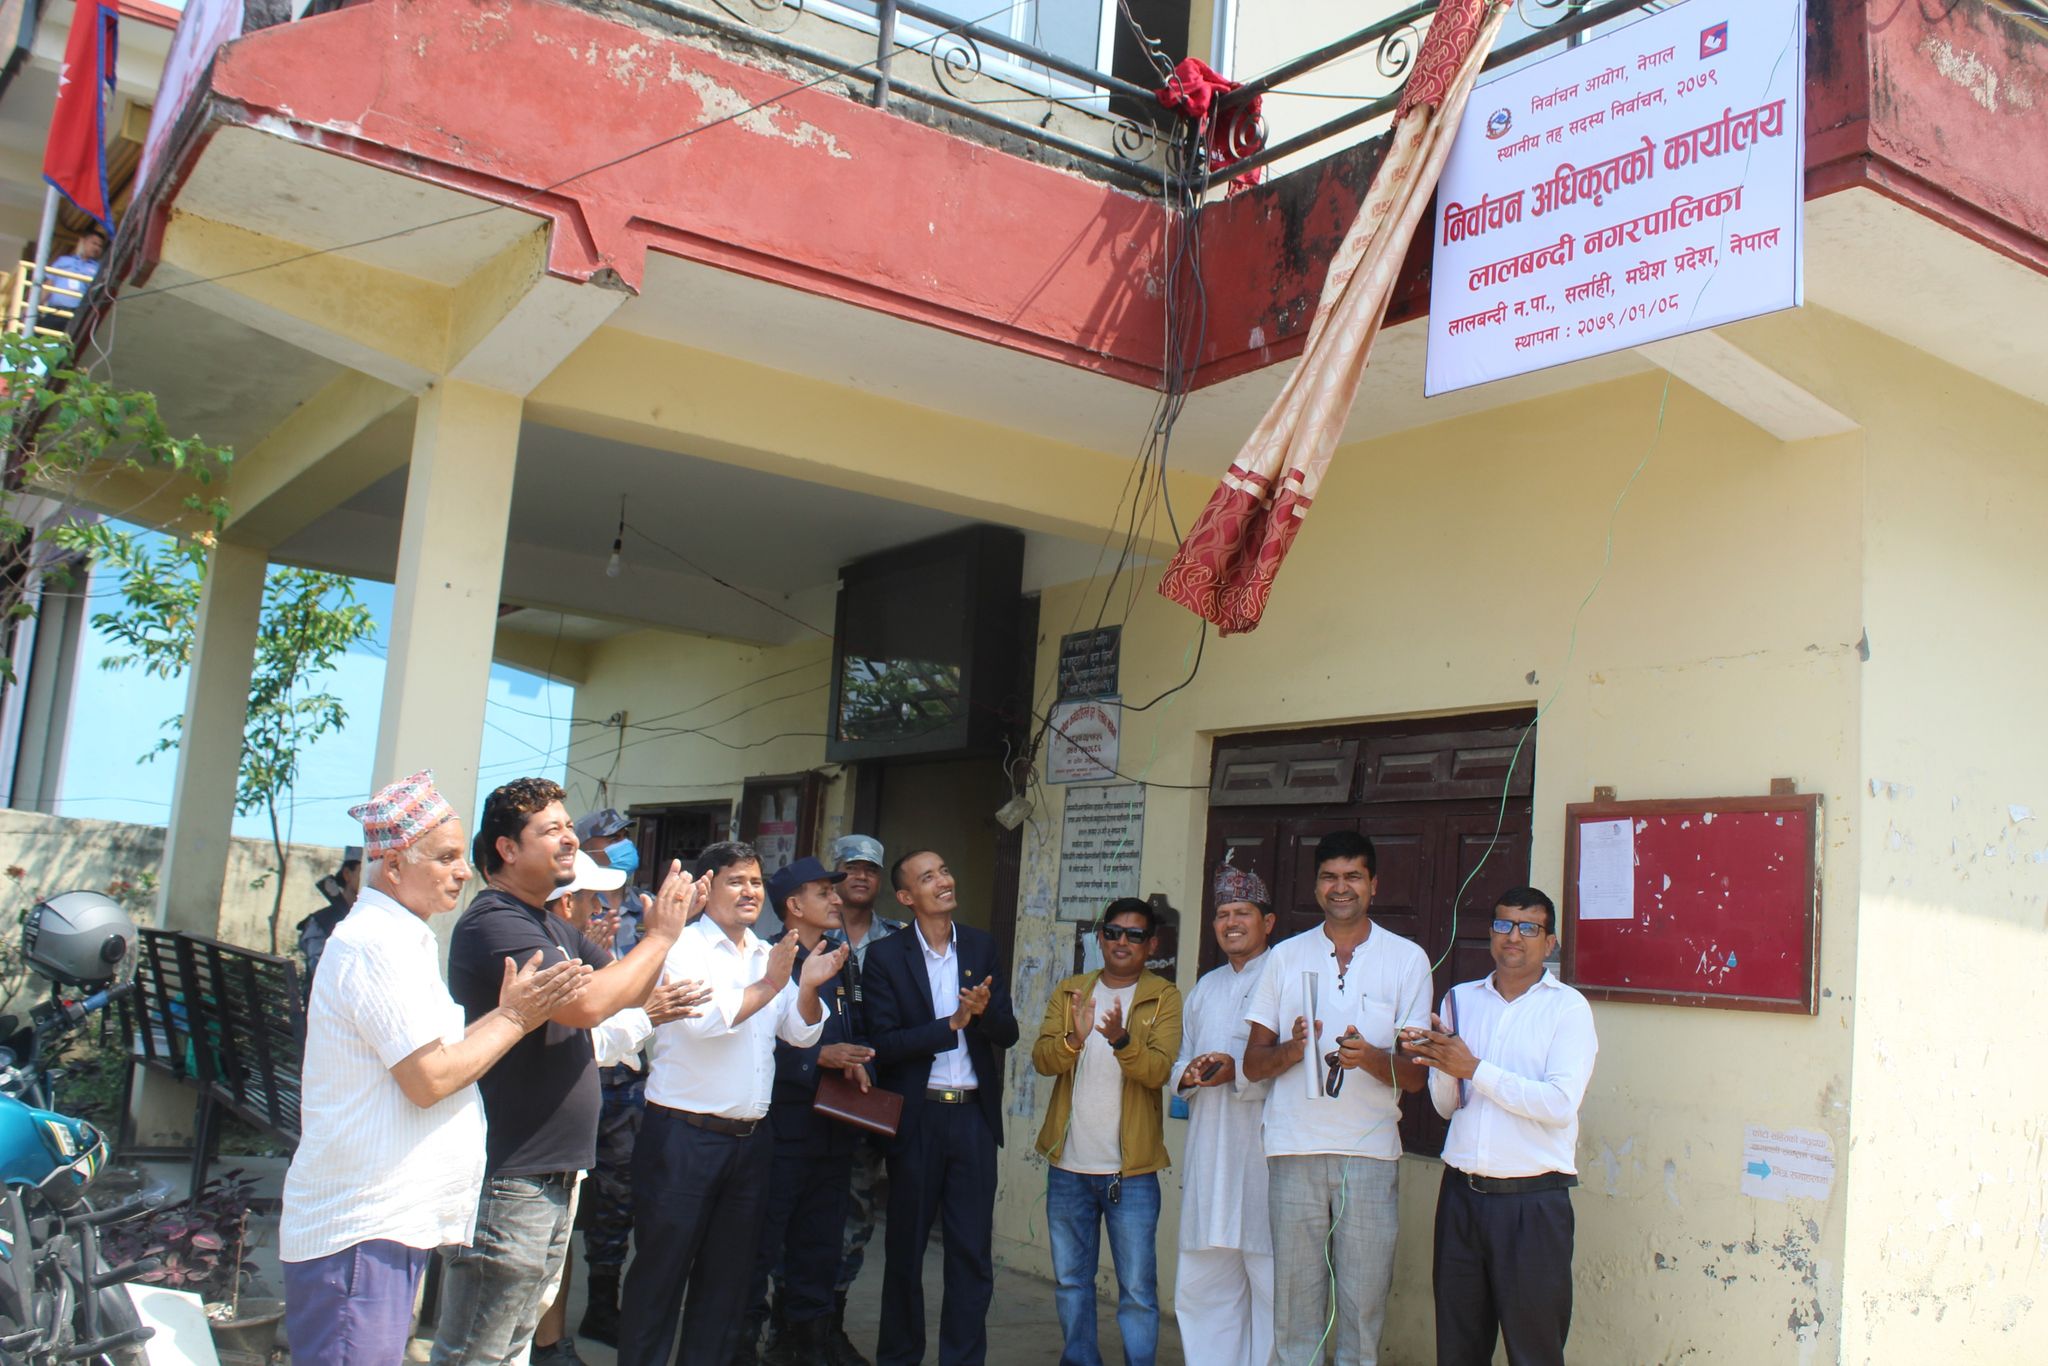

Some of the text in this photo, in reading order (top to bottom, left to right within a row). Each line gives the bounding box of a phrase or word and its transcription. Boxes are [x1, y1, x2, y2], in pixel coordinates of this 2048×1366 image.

[1497, 69, 1718, 162] स्थानीय तह सदस्य निर्वाचन, २०७९
[1531, 46, 1675, 114] निर्वाचन आयोग, नेपाल
[1443, 98, 1786, 247] निर्वाचन अधिकृतको कार्यालय
[1449, 301, 1508, 336] लालबन्दी
[1565, 272, 1615, 304] सर्लाही,
[1625, 259, 1667, 285] मधेश
[1674, 246, 1718, 274] प्रदेश,
[1730, 227, 1780, 255] नेपाल
[1468, 185, 1744, 291] लालबन्दी नगरपालिका
[1514, 326, 1560, 351] स्थापना
